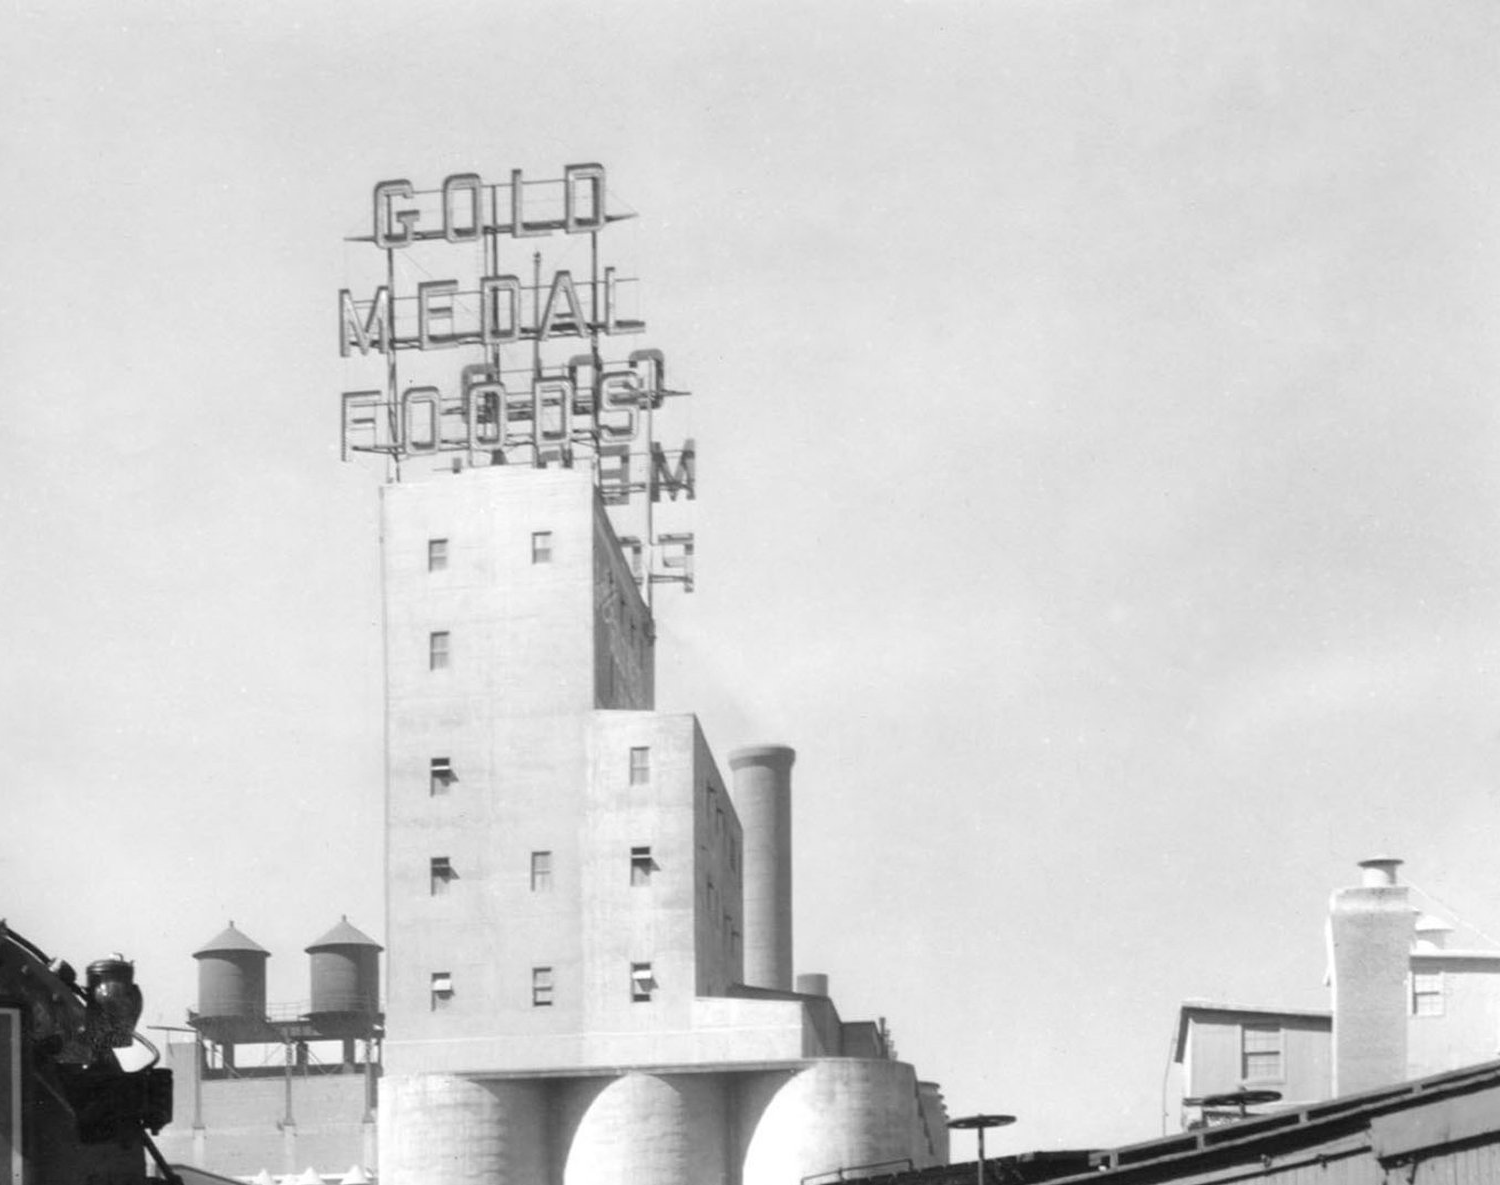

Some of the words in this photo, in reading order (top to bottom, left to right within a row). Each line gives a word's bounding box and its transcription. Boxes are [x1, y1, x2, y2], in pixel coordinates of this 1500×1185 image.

[373, 162, 606, 249] GOLD
[339, 266, 646, 358] MEDAL
[341, 370, 642, 463] FOODS
